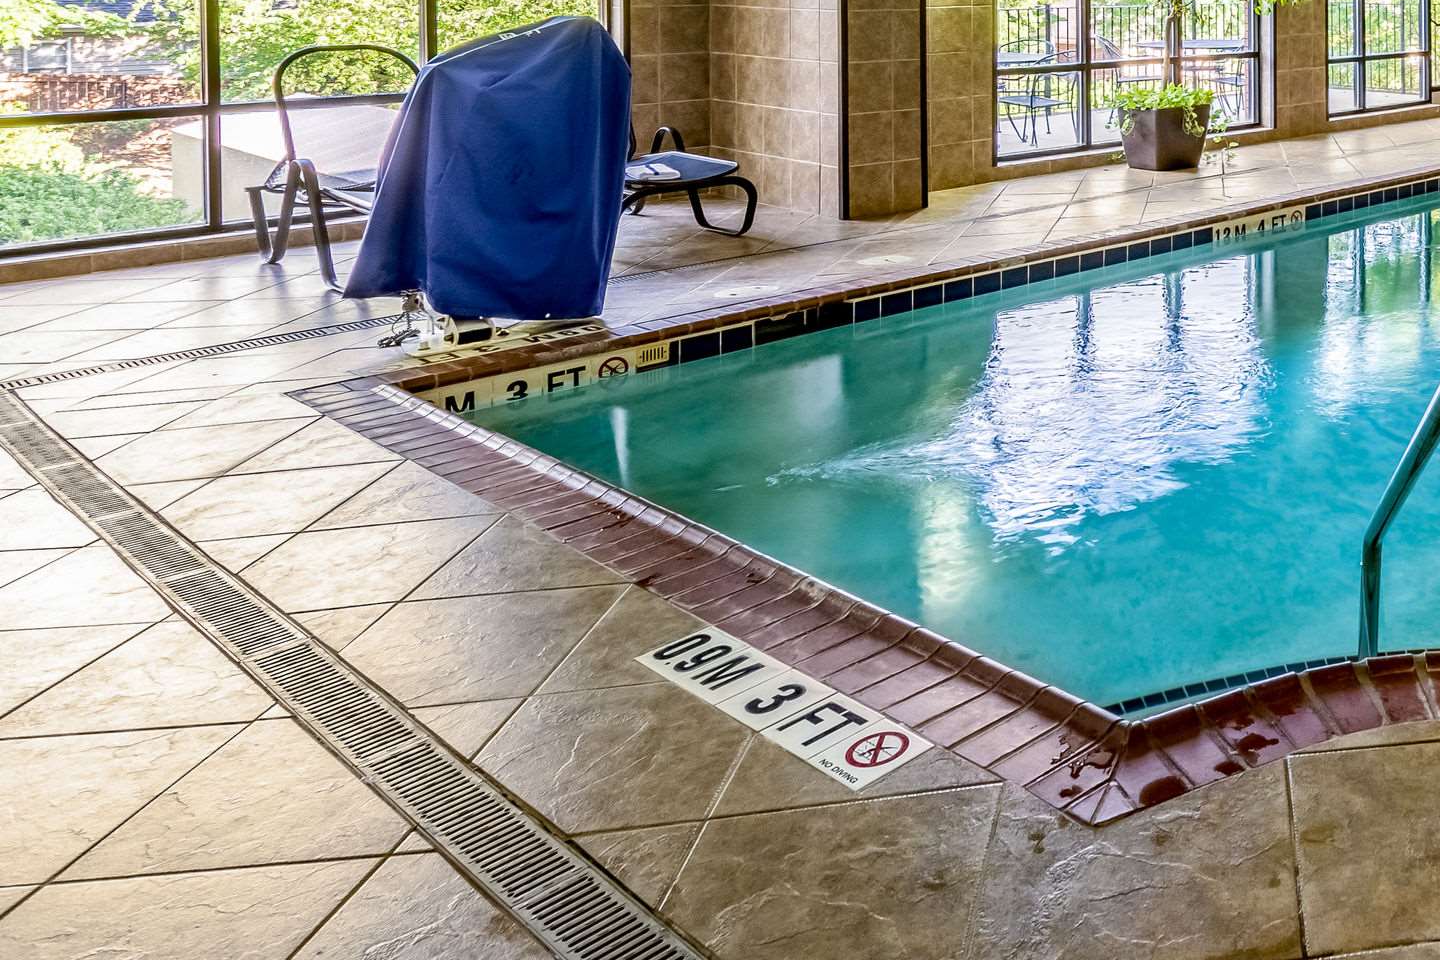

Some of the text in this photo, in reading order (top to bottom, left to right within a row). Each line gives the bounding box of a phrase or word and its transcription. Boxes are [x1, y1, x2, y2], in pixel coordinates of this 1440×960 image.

[1272, 214, 1287, 231] FT
[506, 380, 529, 401] 3
[547, 365, 586, 393] FT
[744, 684, 807, 715] 3
[776, 701, 869, 748] FT
[818, 758, 858, 784] NO DIVING
